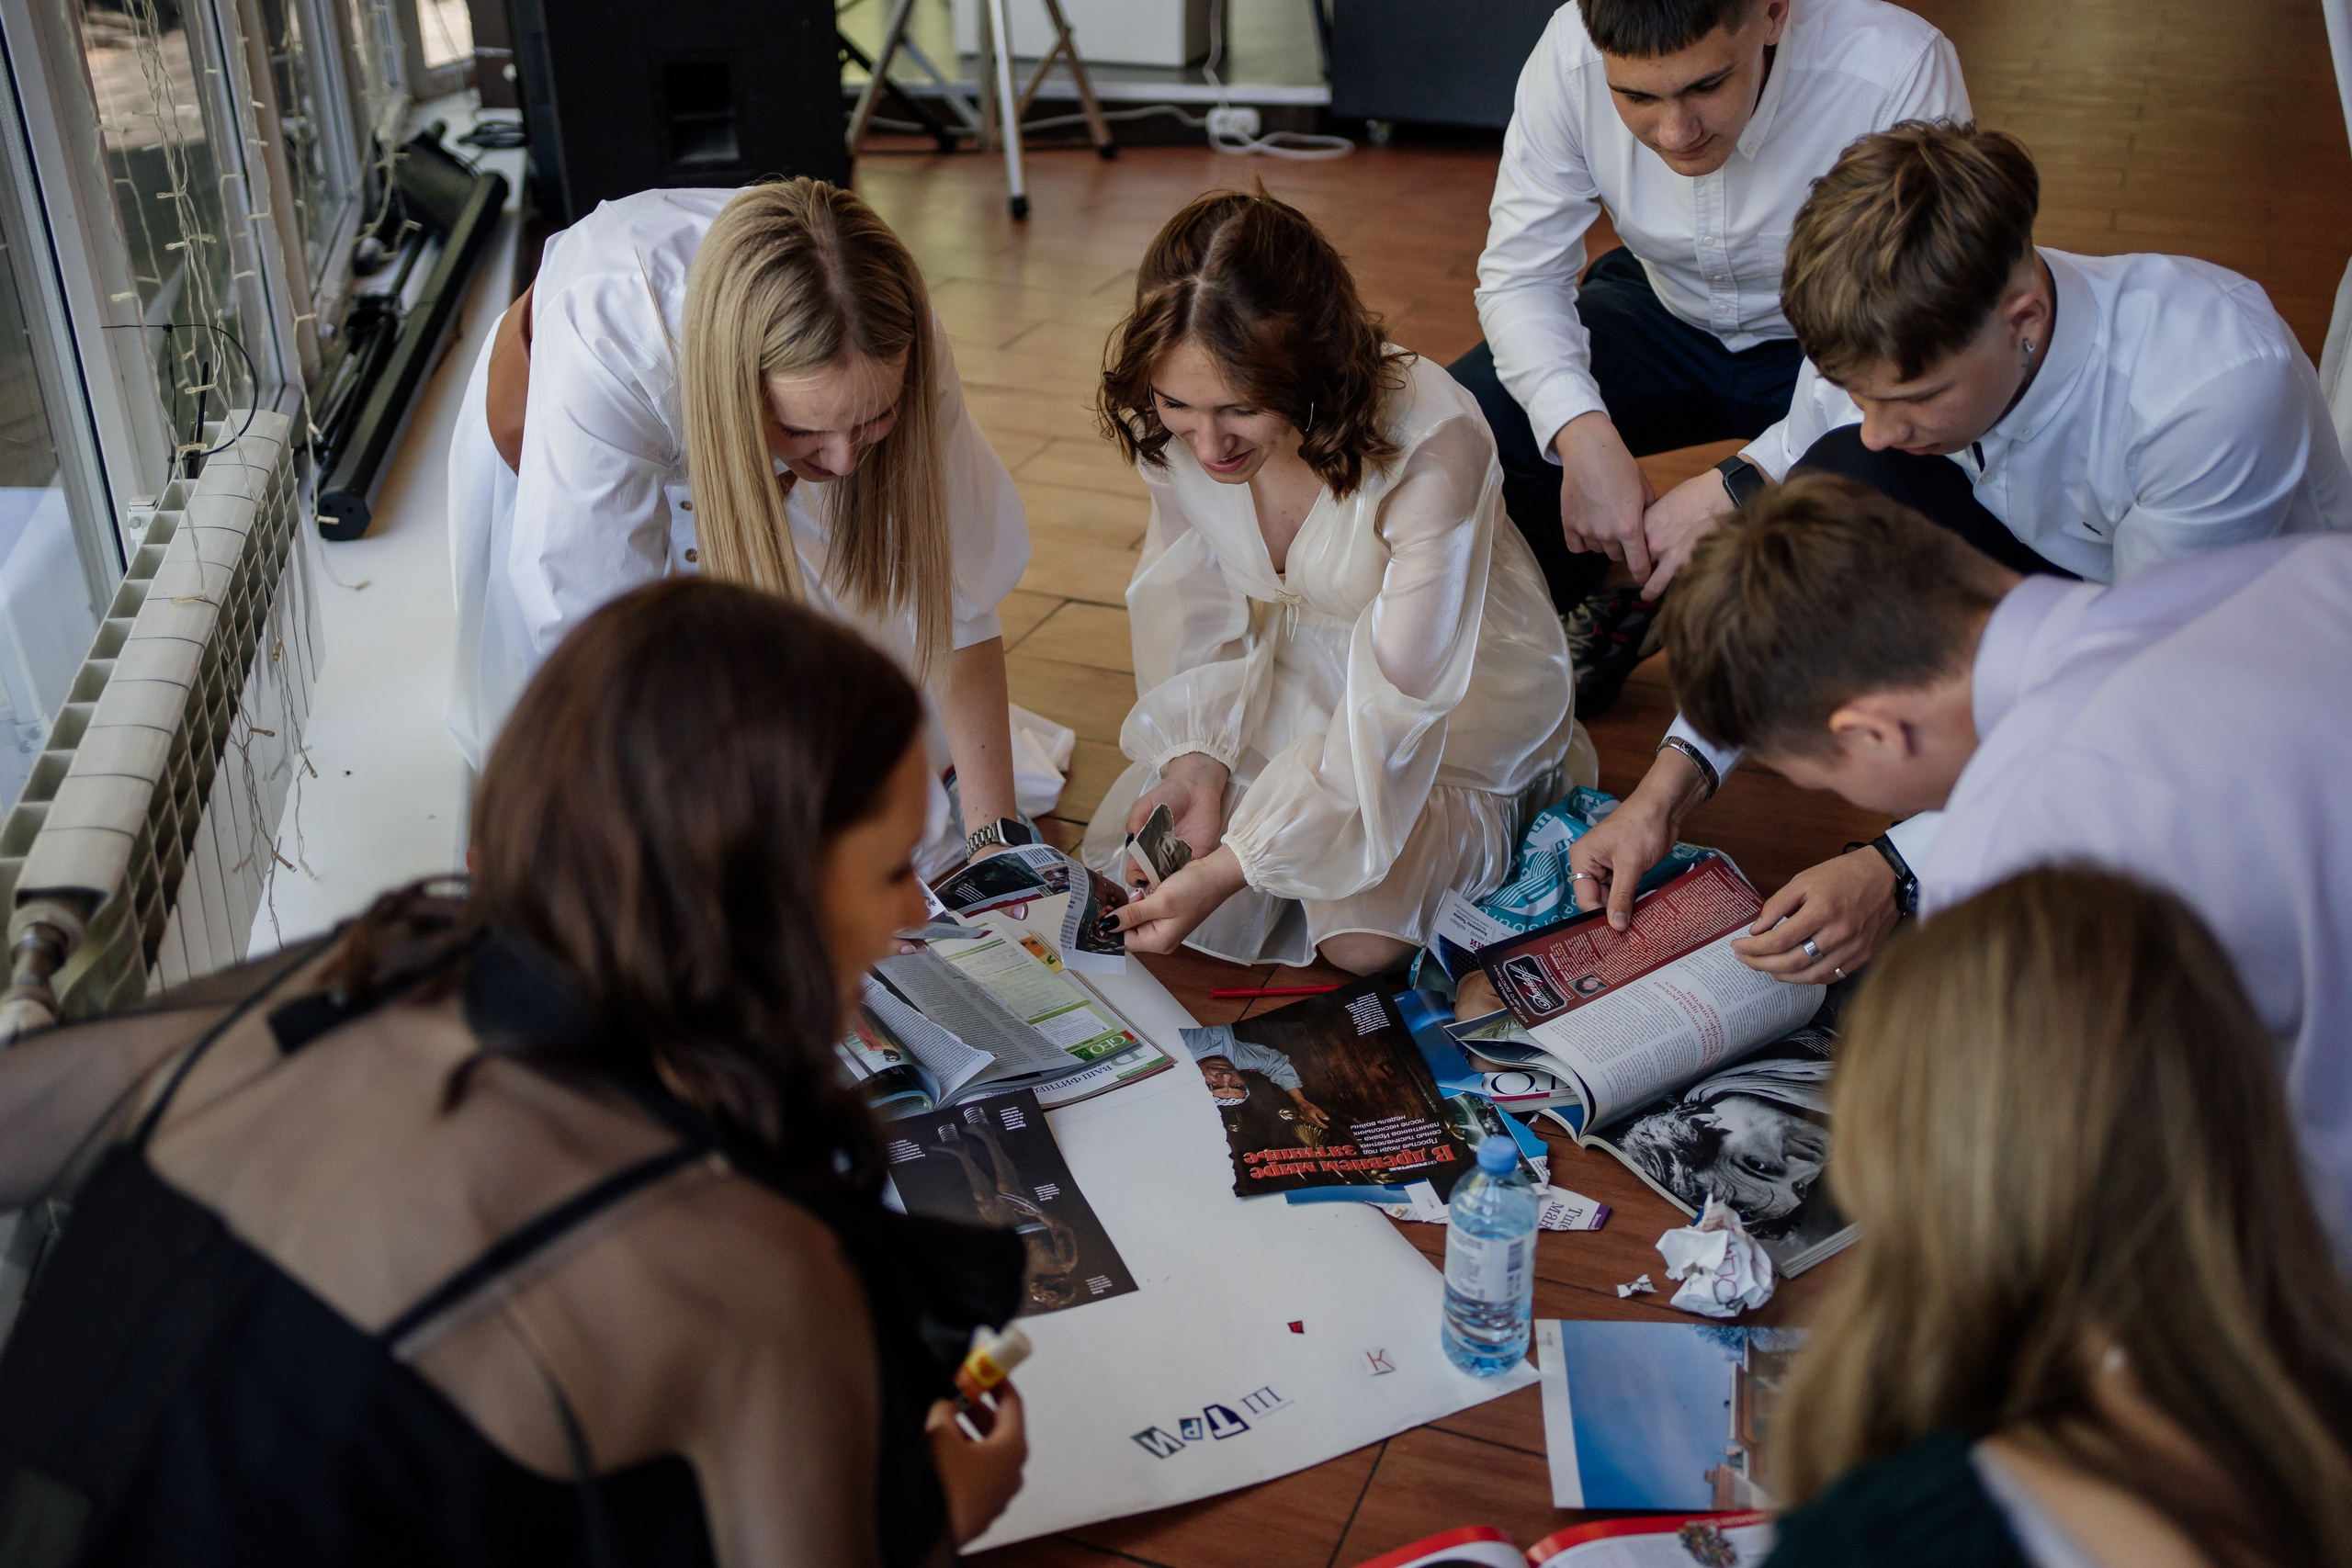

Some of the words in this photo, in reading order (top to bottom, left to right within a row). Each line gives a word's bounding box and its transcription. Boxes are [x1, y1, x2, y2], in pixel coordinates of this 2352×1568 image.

[1089, 1033, 1125, 1055] GEO
[1081, 1065, 1113, 1079] ВАШ
[1377, 1113, 1406, 1124] недель
[1399, 1117, 1424, 1127] после
[1350, 1120, 1376, 1130] войны
[1352, 1122, 1399, 1136] нескольких
[1363, 1132, 1389, 1142] Ирака
[1401, 1137, 1437, 1148] Простые
[1362, 1147, 1377, 1156] под
[1379, 1143, 1401, 1153] люди
[1430, 1144, 1456, 1164] В
[1241, 1143, 1357, 1166] затишье
[1318, 1147, 1427, 1170] древнем
[1249, 1160, 1317, 1180] мире
